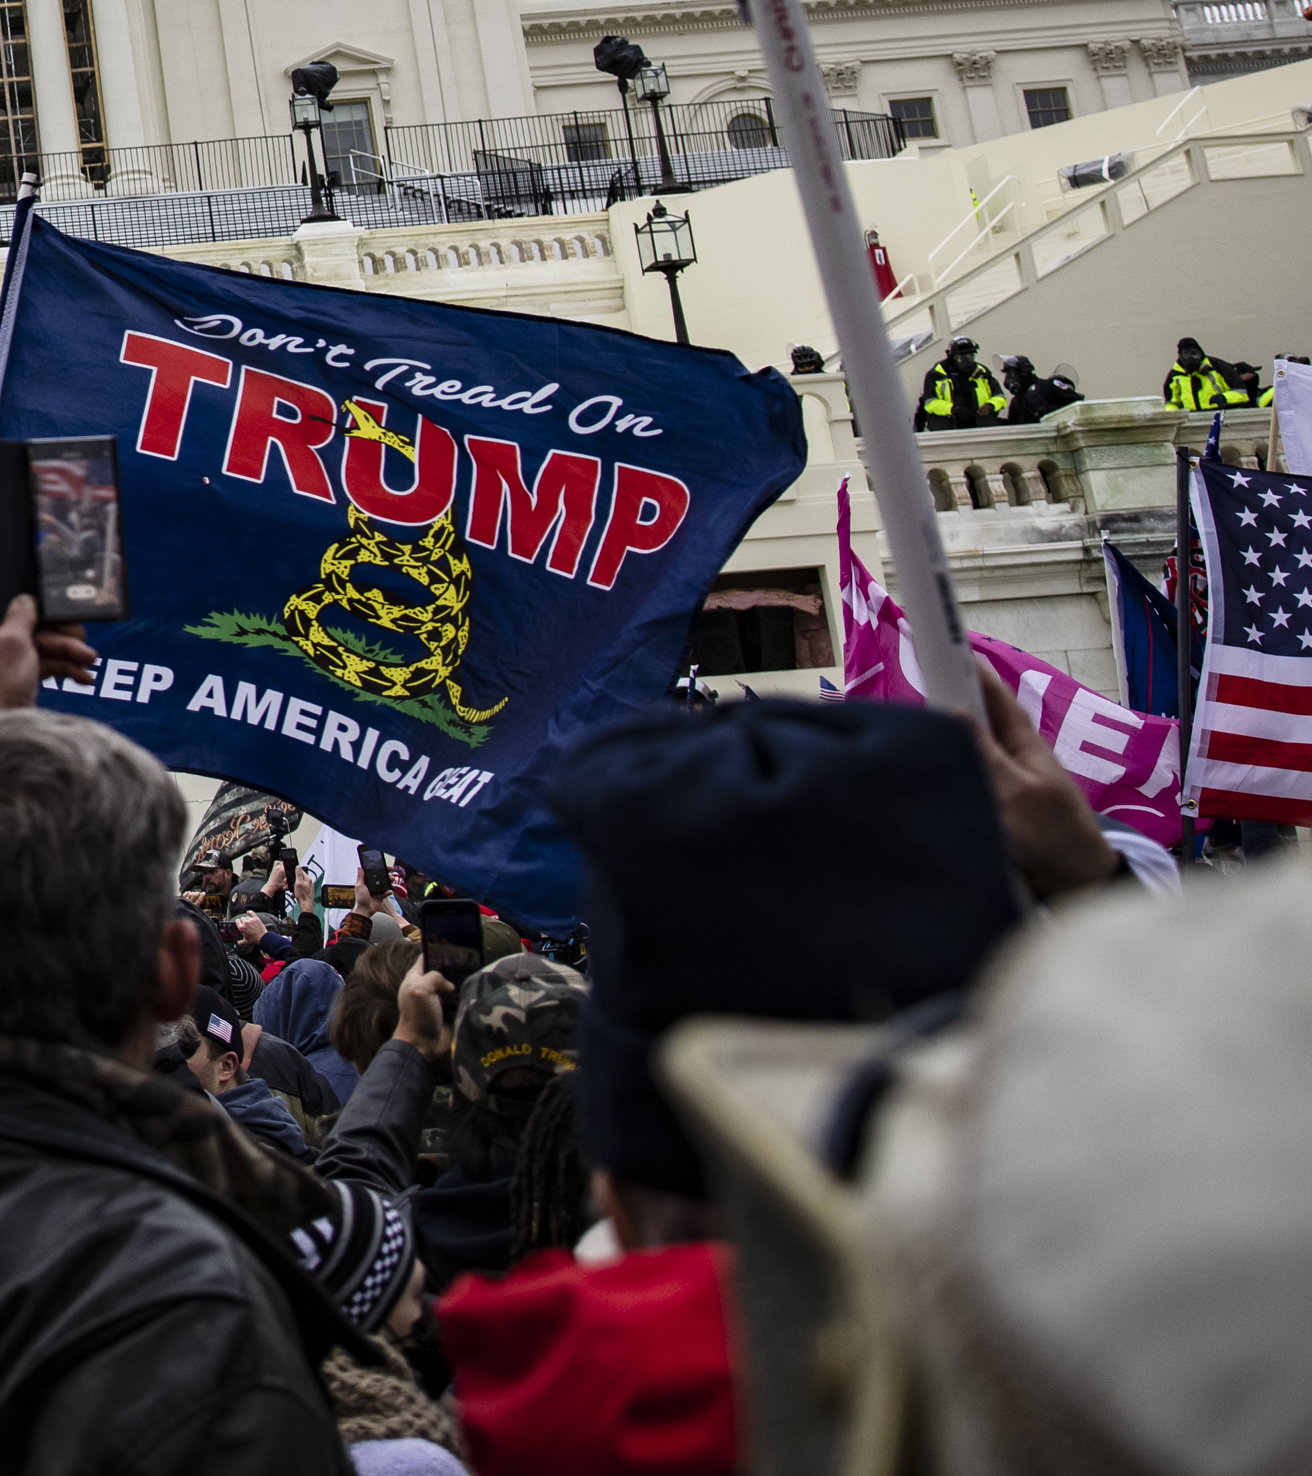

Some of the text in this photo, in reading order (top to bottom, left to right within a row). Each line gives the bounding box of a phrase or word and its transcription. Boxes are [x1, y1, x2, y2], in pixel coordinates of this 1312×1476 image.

[174, 315, 663, 438] Don't Tread On
[119, 329, 691, 591] TRUMP
[42, 657, 175, 705] EEP
[186, 673, 431, 801] AMERICA
[480, 1044, 577, 1071] DONALD TRUM
